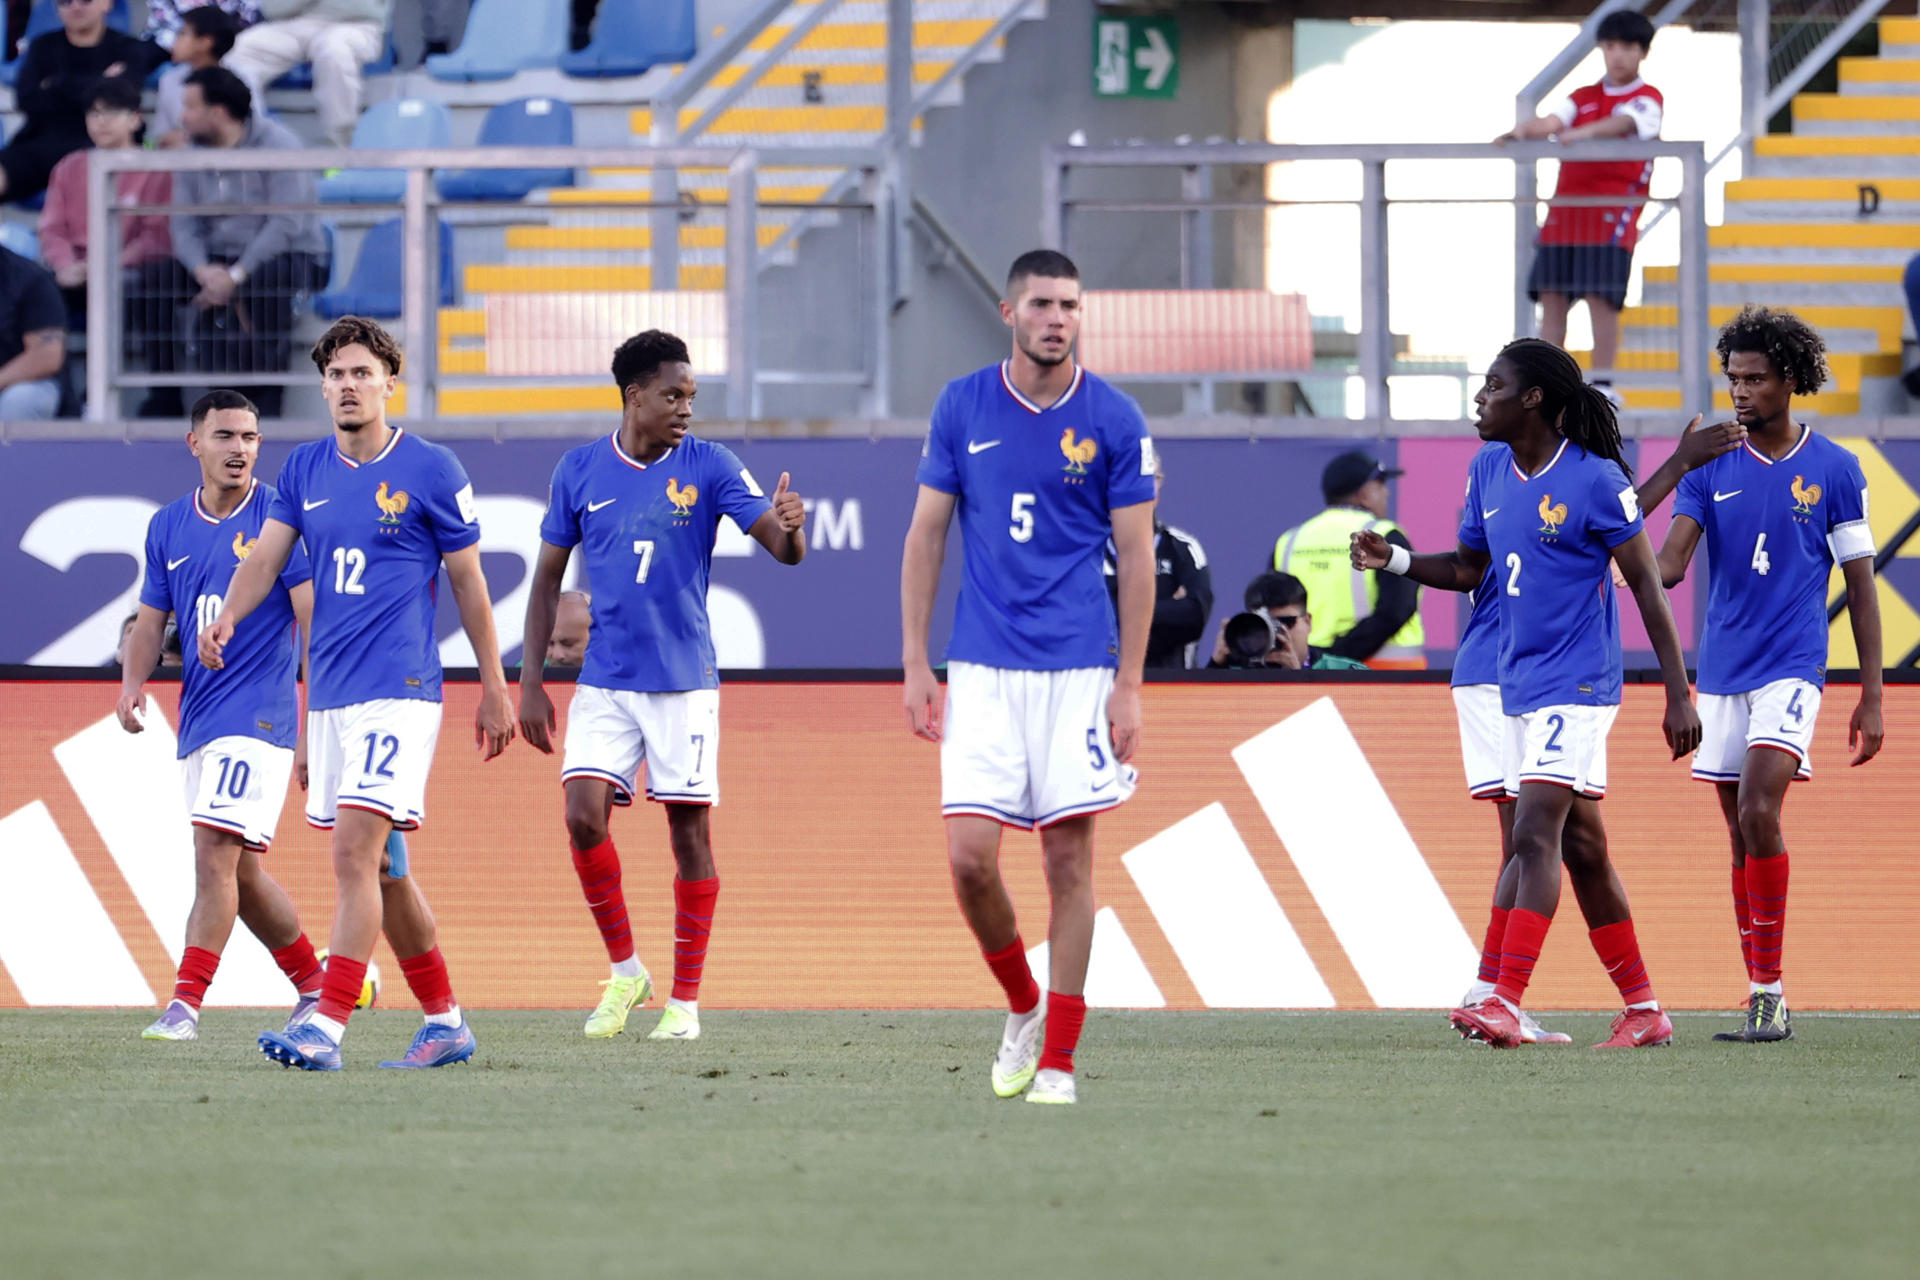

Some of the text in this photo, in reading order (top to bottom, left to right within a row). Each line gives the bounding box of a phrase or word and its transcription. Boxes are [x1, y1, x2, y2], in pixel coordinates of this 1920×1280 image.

[1859, 186, 1879, 216] D
[1009, 493, 1036, 543] 5
[333, 547, 366, 595] 12
[633, 540, 654, 584] 7
[1506, 552, 1522, 597] 2
[1752, 533, 1771, 576] 4
[196, 594, 224, 636] 10
[1786, 688, 1803, 723] 4
[690, 734, 704, 773] 7
[1087, 728, 1105, 771] 5
[1545, 714, 1564, 752] 2
[364, 732, 400, 778] 12
[216, 756, 250, 799] 10
